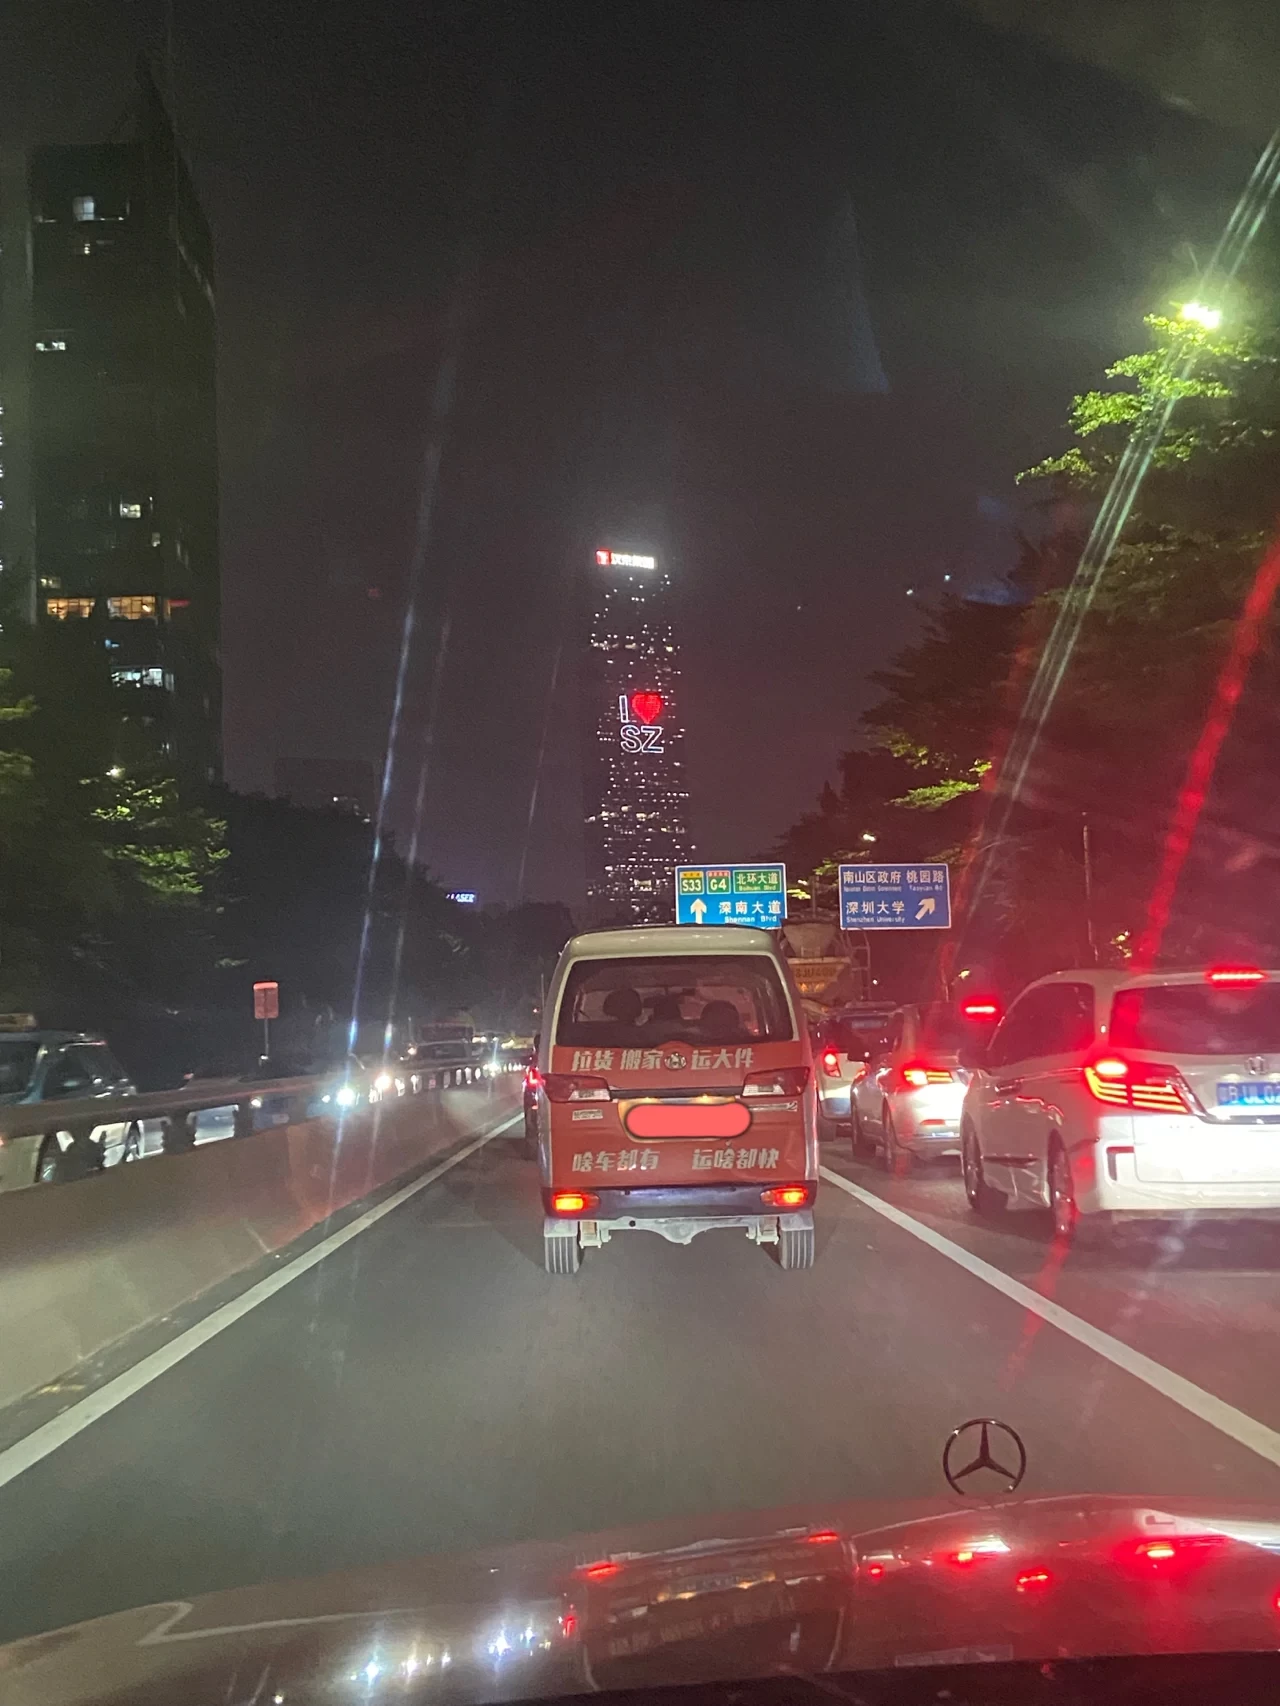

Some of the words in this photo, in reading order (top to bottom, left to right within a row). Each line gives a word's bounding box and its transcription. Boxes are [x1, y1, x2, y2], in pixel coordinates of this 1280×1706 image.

[619, 695, 628, 723] I
[620, 725, 664, 753] SZ
[736, 872, 778, 884] 北环大道
[843, 870, 901, 884] 南山区政府
[906, 870, 944, 883] 桃园路
[682, 878, 702, 892] S33
[710, 878, 727, 891] G4
[718, 900, 782, 914] 深南大道
[846, 900, 905, 914] 深圳大学
[571, 1050, 614, 1072] 拉货
[620, 1050, 664, 1070] 搬家
[691, 1048, 754, 1070] 运大件
[572, 1148, 660, 1172] 啥车都有
[692, 1148, 780, 1170] 运啥都快
